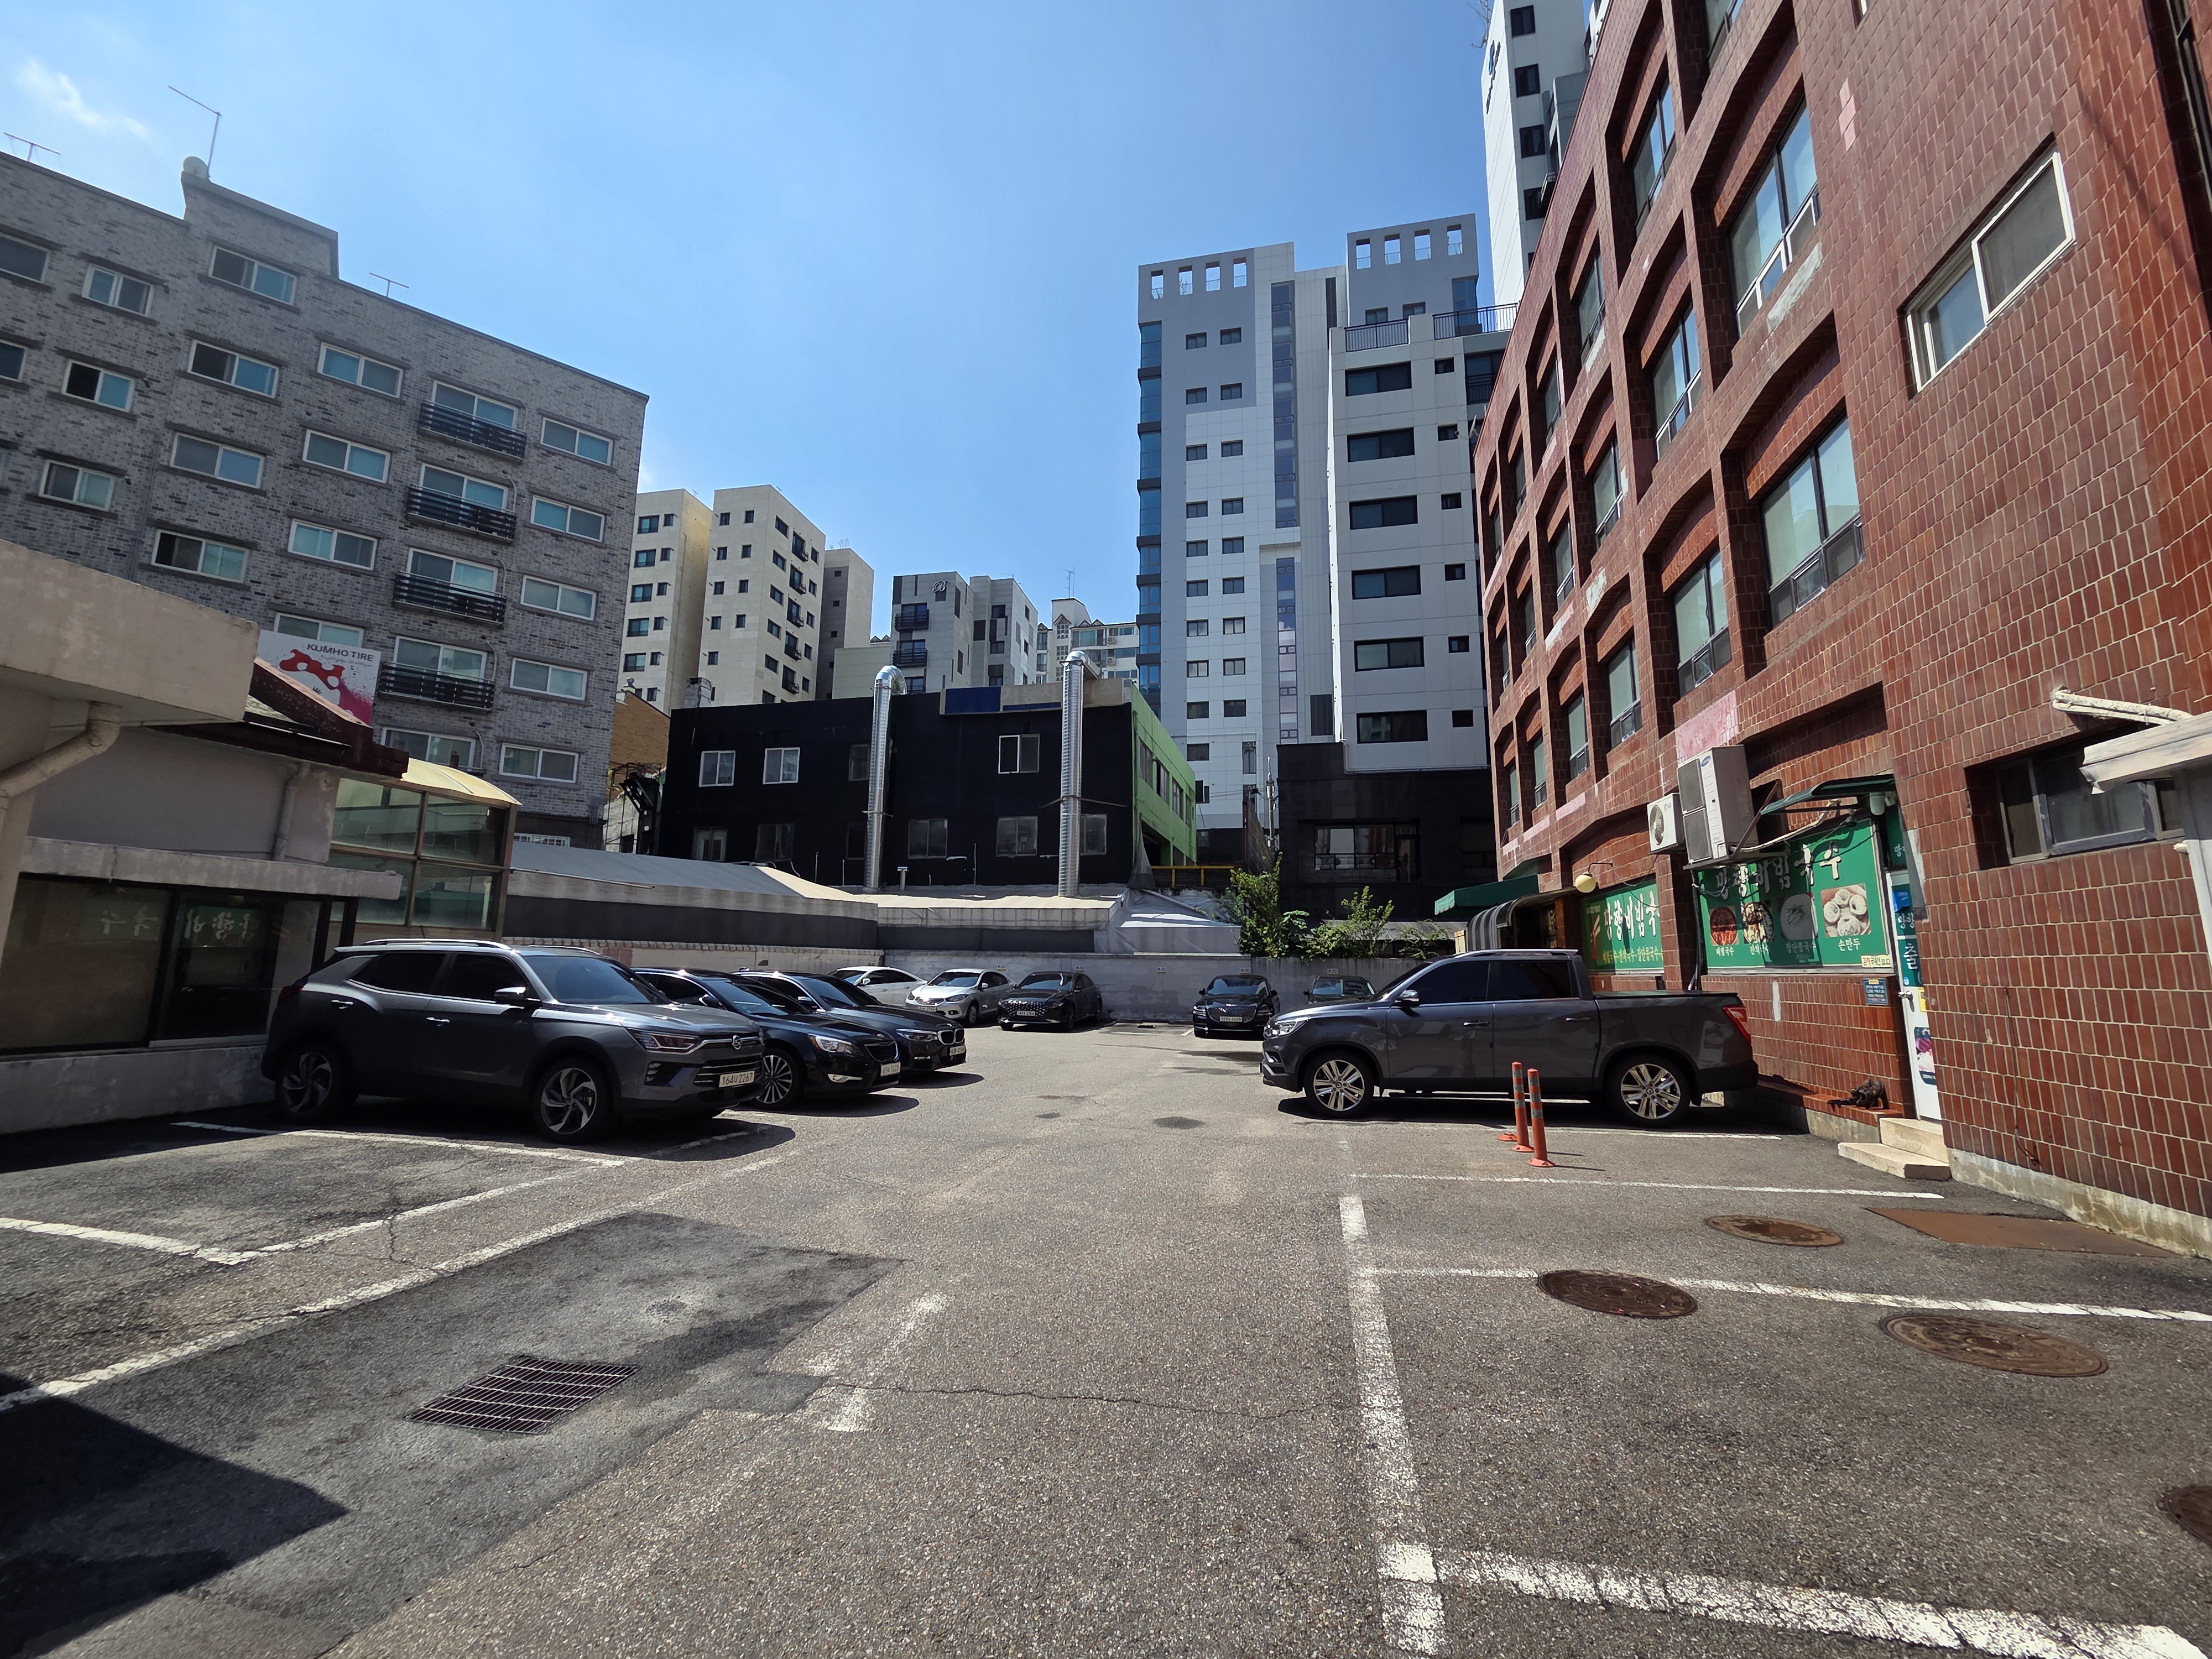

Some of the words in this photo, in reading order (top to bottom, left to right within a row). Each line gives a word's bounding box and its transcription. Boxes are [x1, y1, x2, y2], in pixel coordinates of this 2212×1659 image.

[307, 643, 349, 657] KUMHO
[351, 651, 374, 662] TIRE
[1604, 890, 1660, 941] 망향비빔국
[1838, 938, 1861, 951] 손만두
[738, 1072, 753, 1083] 2267
